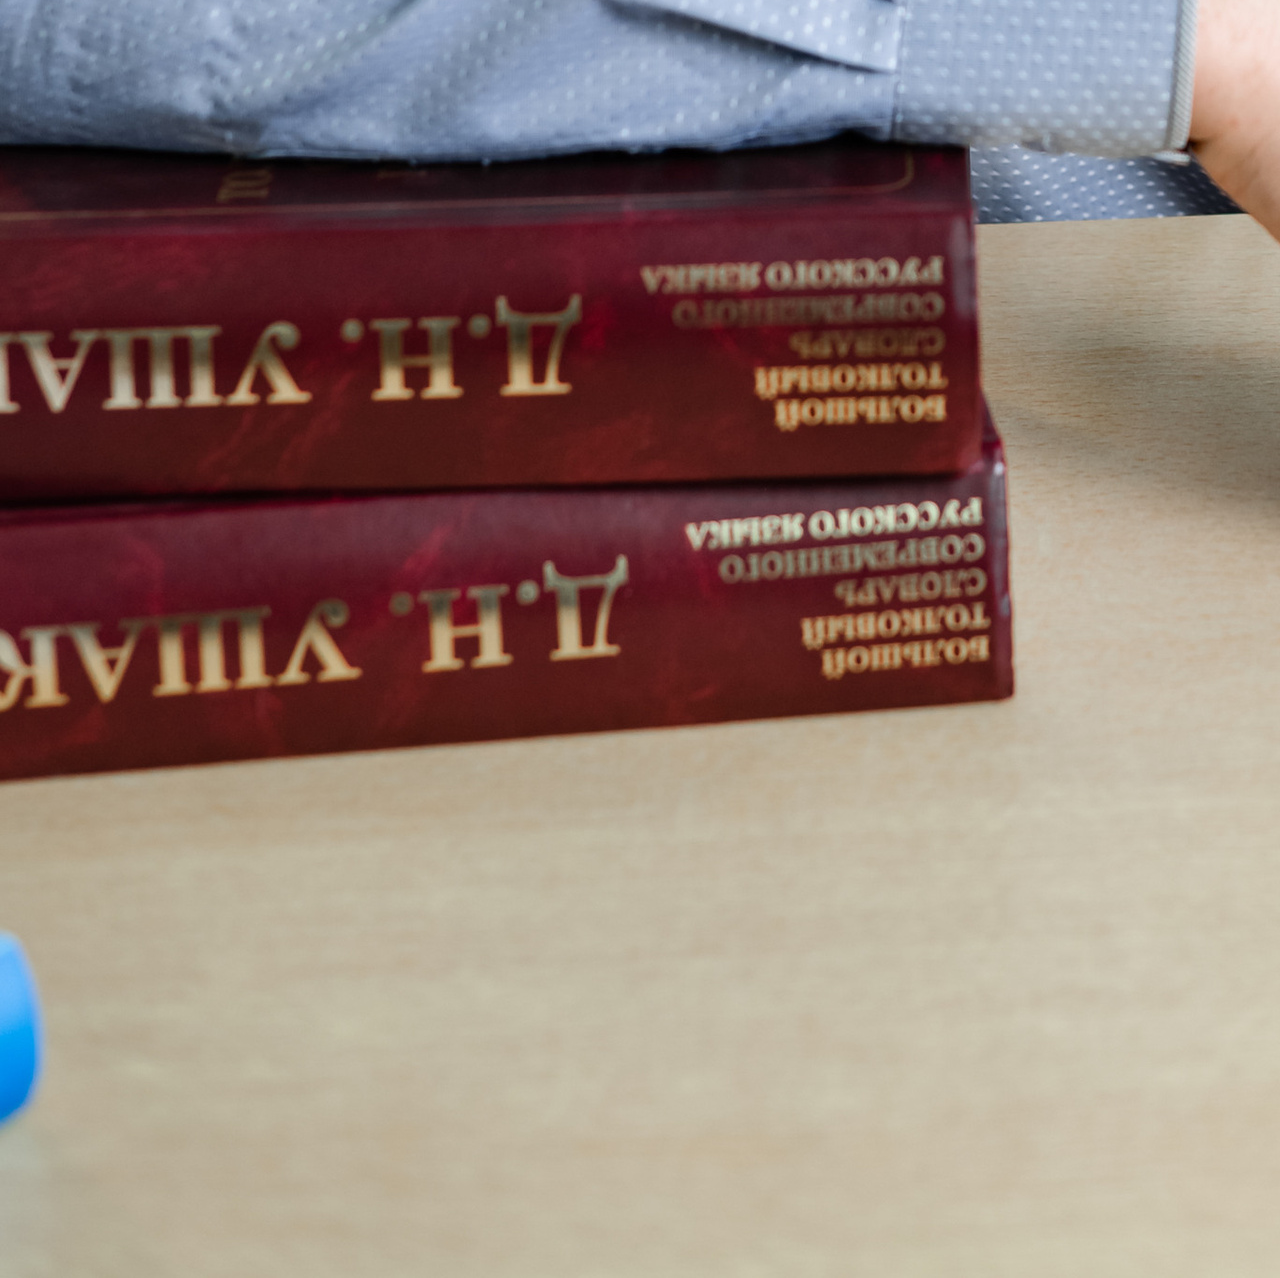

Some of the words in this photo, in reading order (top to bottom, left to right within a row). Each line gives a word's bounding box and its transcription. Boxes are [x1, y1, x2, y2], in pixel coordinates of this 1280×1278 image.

[640, 262, 762, 294] ЯЗЫКА
[764, 256, 945, 291] РУССКОГО
[672, 292, 945, 329] СОВРЕМЕННОГО
[341, 293, 582, 401] Д.Н.
[789, 327, 946, 359] СЛОВАРЬ
[754, 362, 948, 400] ТОЛКОВЫЙ
[775, 395, 947, 432] БОЛЬШОЙ
[685, 512, 805, 551] ЯЗЫКА
[808, 497, 984, 540] РУССКОГО
[718, 533, 986, 584] СОВРЕМЕННОГО
[834, 567, 988, 607] СЛОВАРЬ
[390, 554, 629, 672] Д.Н.
[801, 602, 991, 650] ТОЛКОВЫЙ
[822, 635, 990, 680] БОЛЬШОЙ
